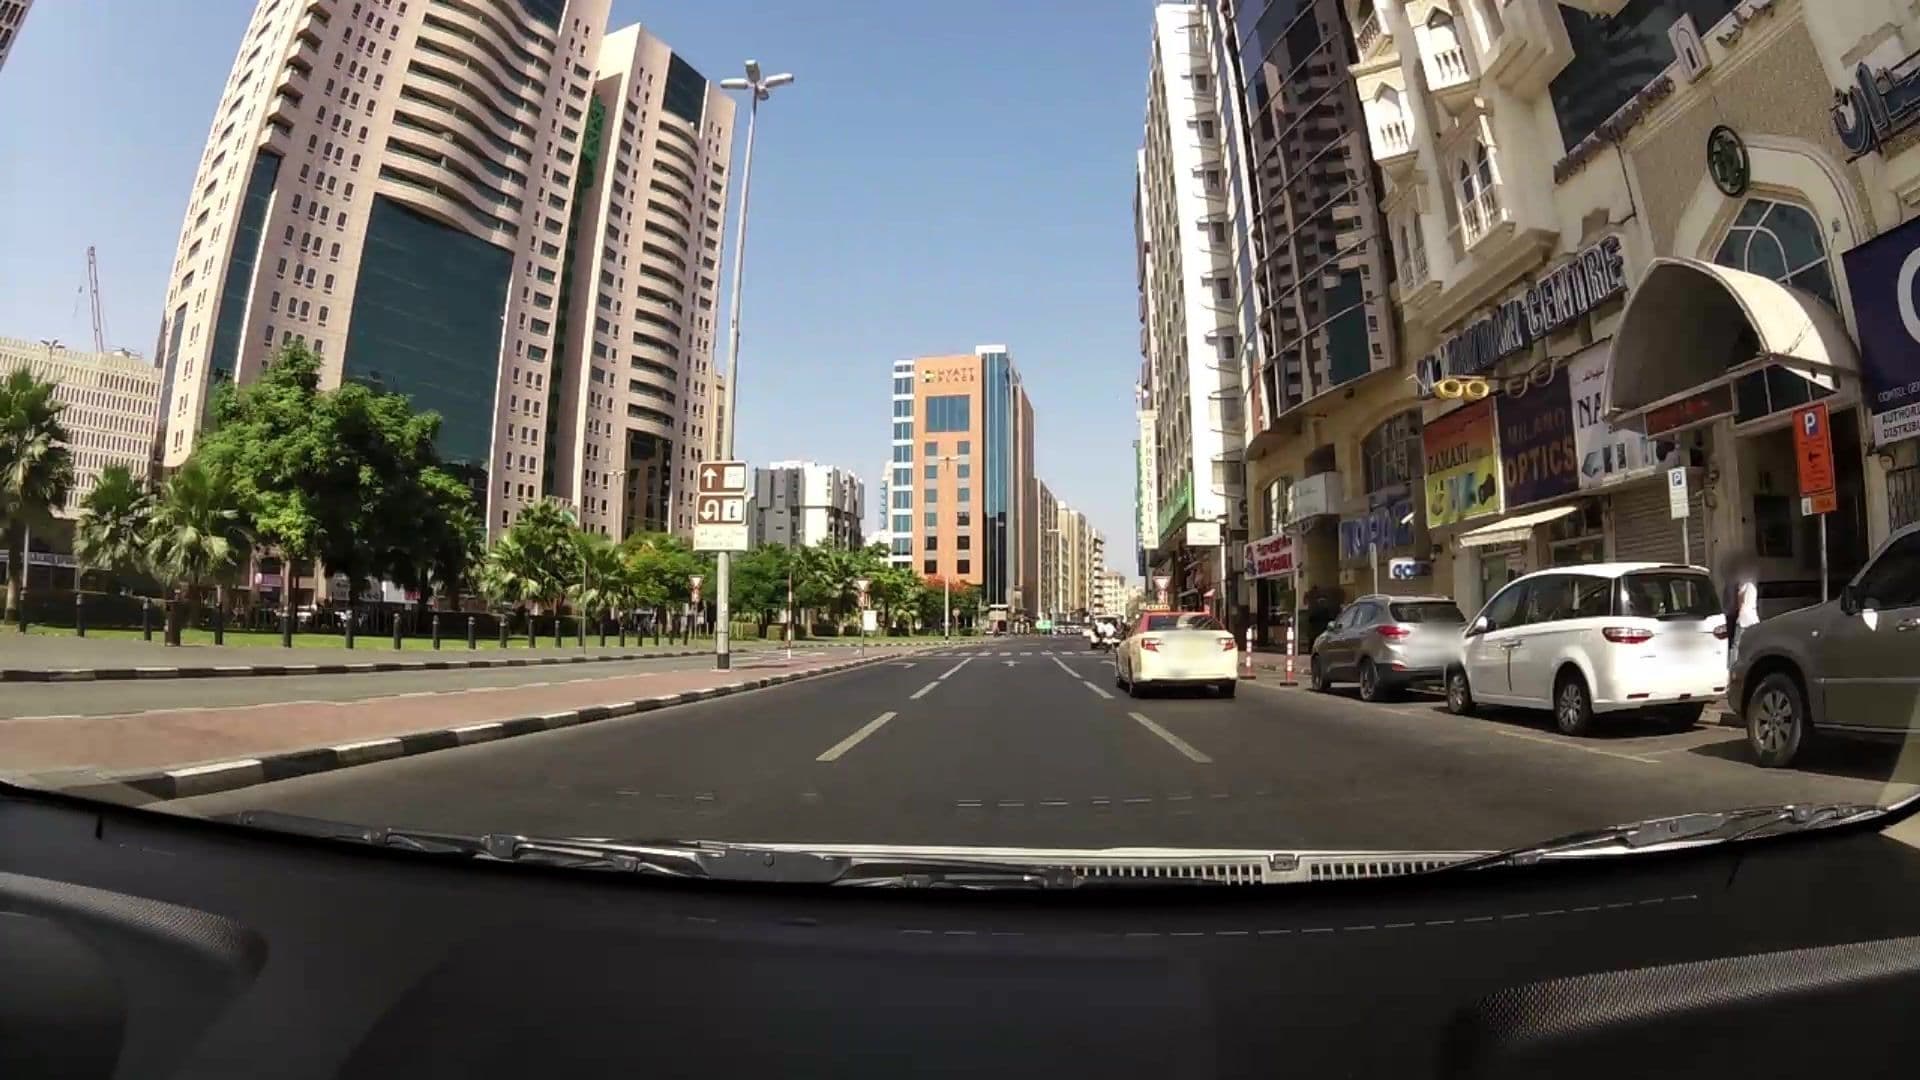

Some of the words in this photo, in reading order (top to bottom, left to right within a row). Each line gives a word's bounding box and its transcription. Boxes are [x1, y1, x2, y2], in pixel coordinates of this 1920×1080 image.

[1525, 235, 1625, 336] CENTRE
[938, 367, 975, 375] HYATT
[1506, 435, 1575, 488] OPTICS
